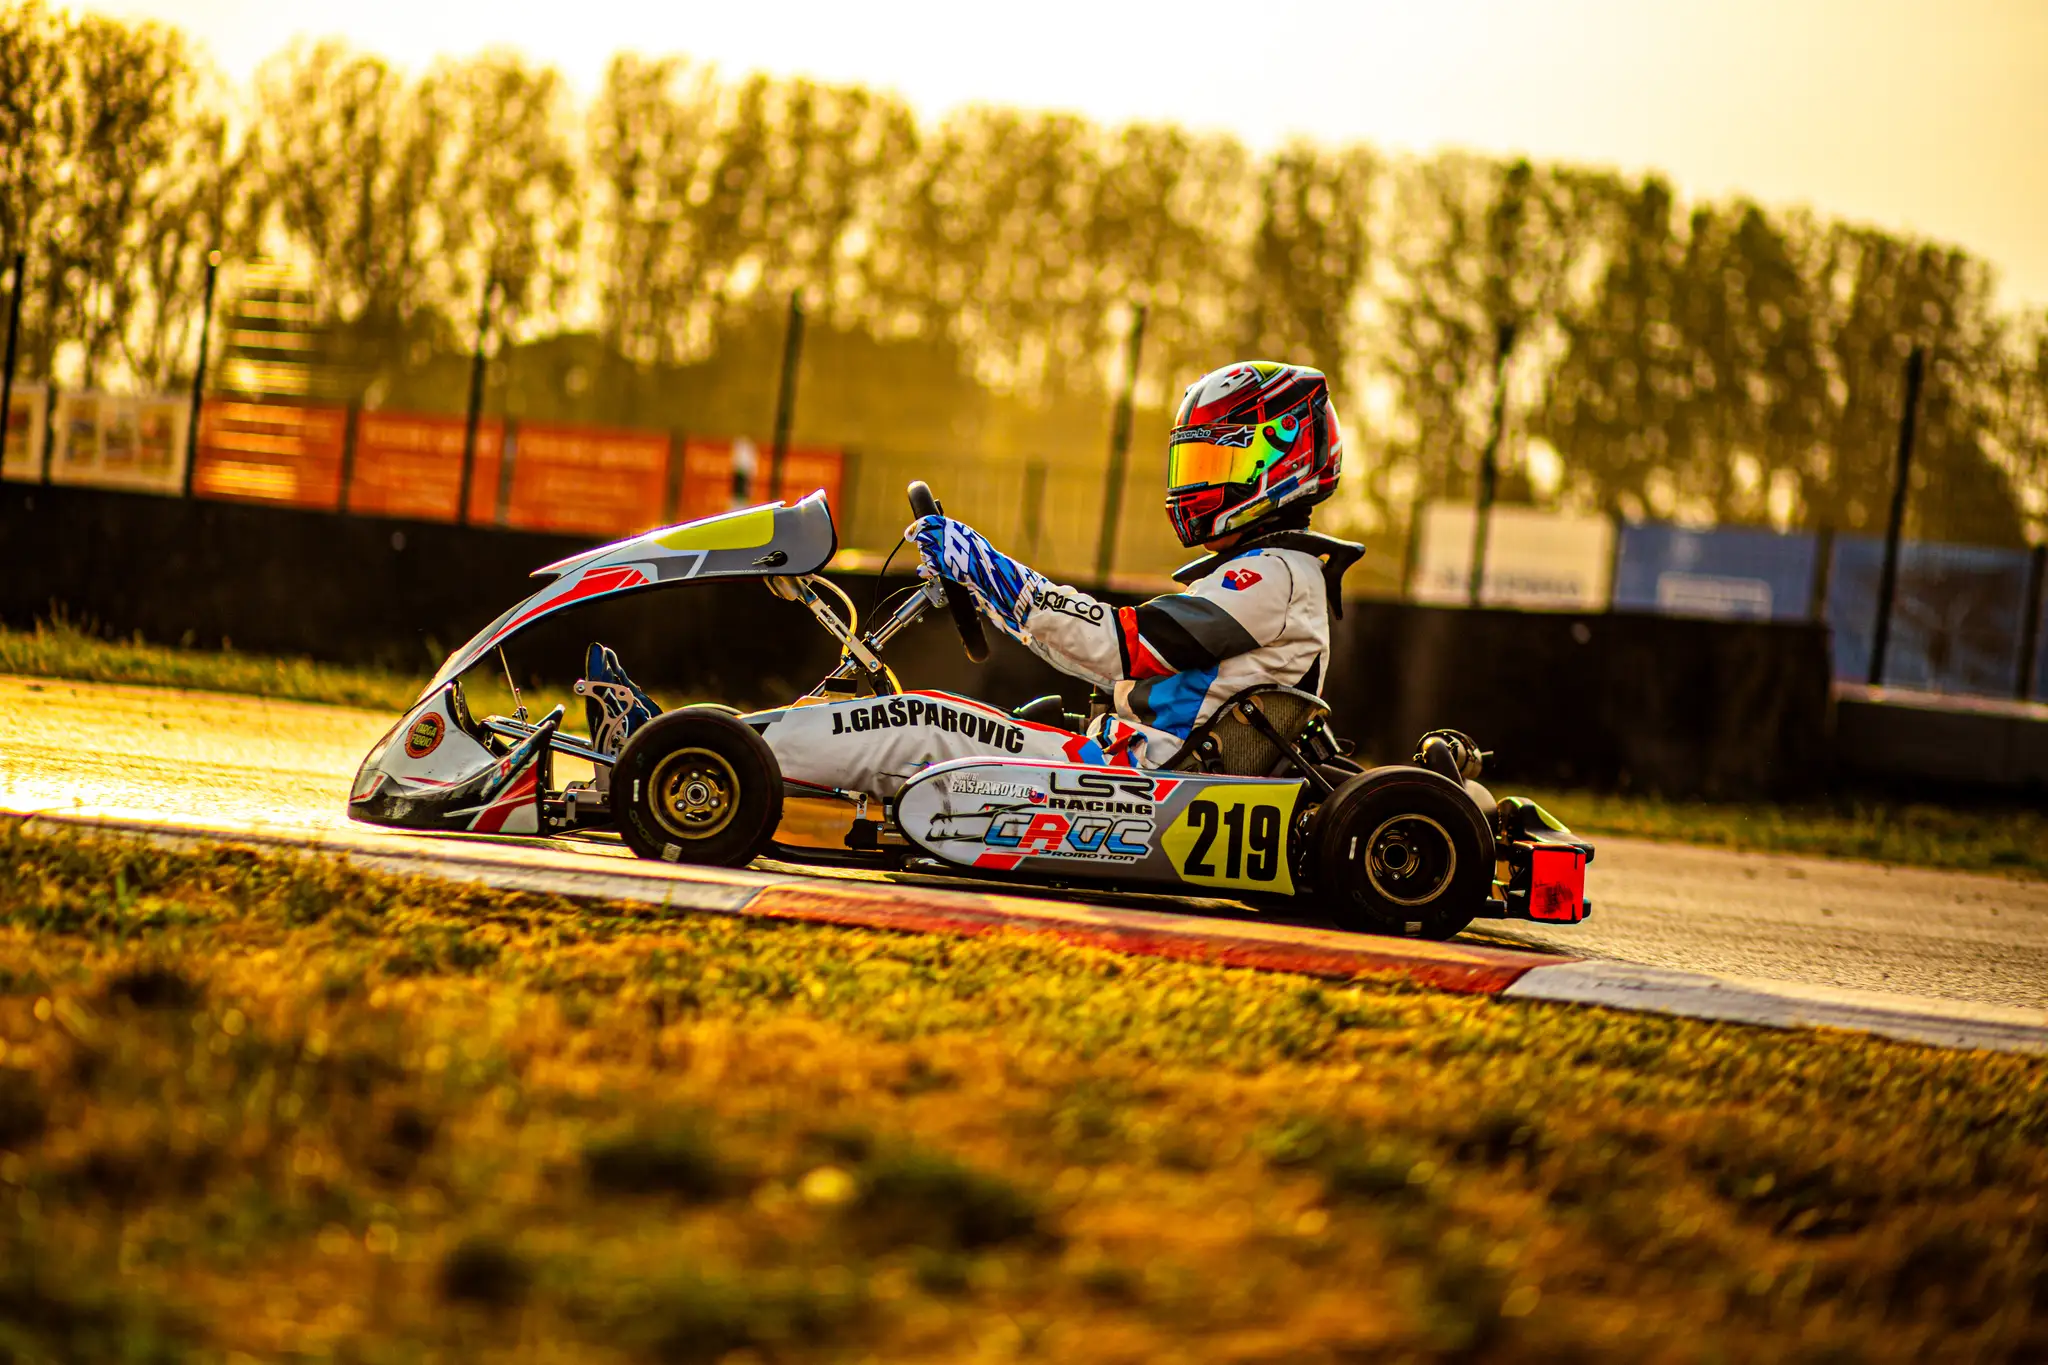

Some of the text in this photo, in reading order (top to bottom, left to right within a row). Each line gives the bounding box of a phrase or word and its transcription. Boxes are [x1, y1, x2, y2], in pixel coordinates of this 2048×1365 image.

[415, 723, 437, 738] TARGA
[832, 697, 1025, 754] J.GAŠPAROVIČ
[1049, 798, 1153, 815] RACING
[1184, 800, 1281, 882] 219
[1038, 848, 1136, 862] PROMOTION
